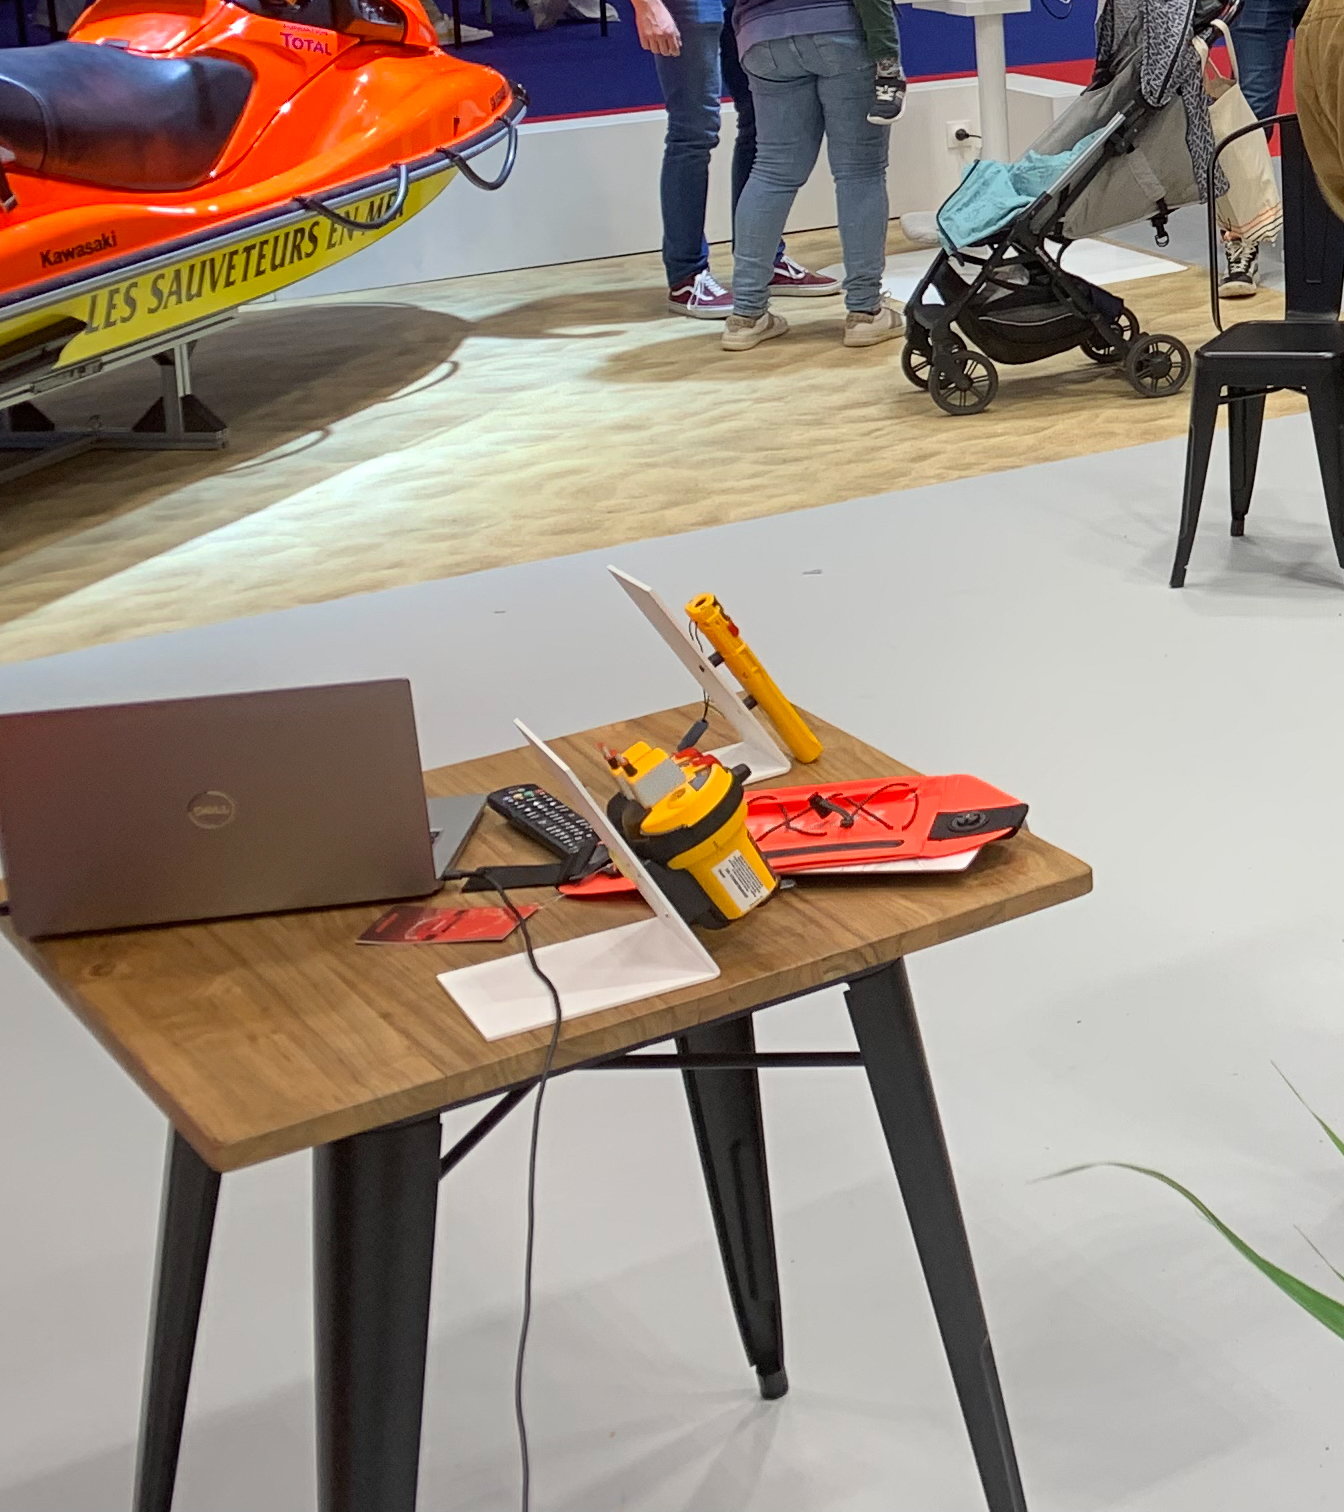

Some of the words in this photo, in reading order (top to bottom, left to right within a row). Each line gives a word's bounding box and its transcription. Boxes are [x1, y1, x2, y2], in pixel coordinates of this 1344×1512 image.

[279, 31, 333, 57] TOTAL
[39, 229, 119, 269] Kawasaki
[85, 280, 139, 334] LES
[146, 220, 320, 315] SAUVETEURS
[325, 207, 355, 252] EN
